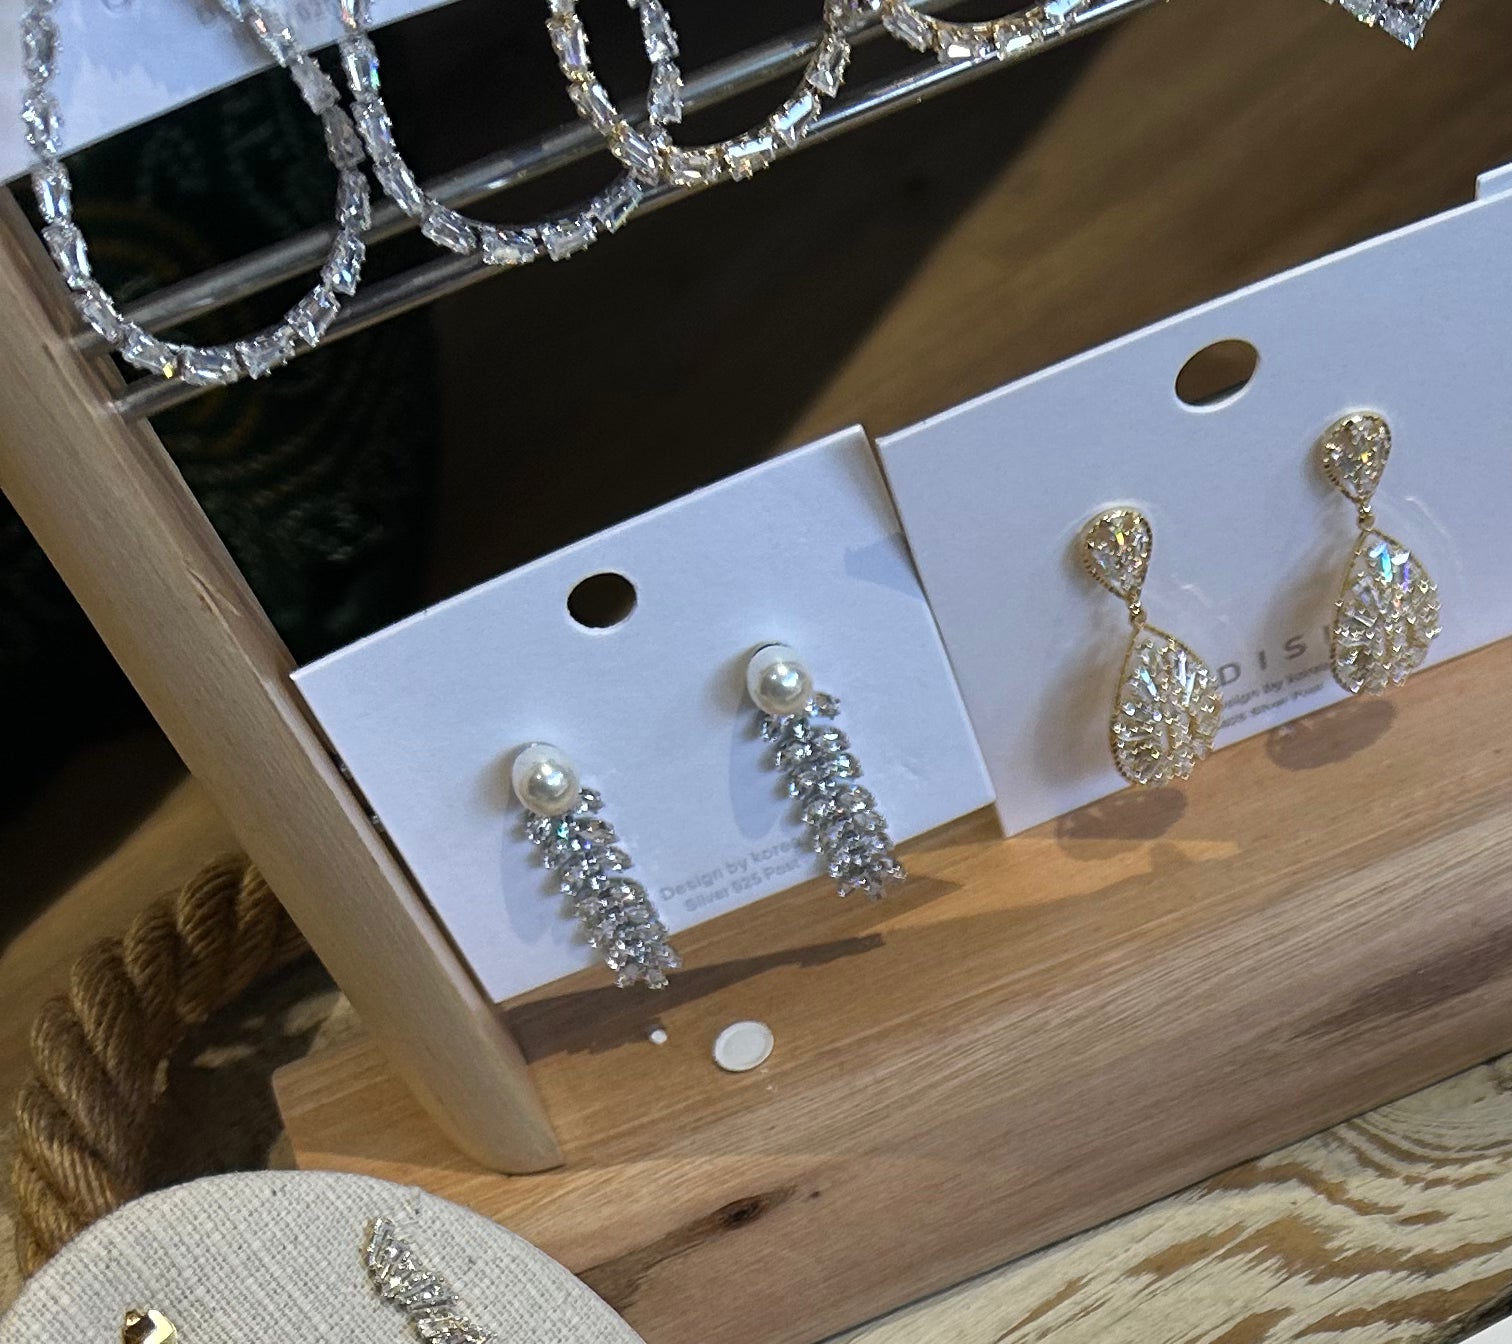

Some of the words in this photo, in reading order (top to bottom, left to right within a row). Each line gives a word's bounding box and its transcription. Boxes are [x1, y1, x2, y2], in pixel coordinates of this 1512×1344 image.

[659, 868, 724, 901] Design
[725, 858, 748, 876] by
[683, 886, 730, 912] Silver
